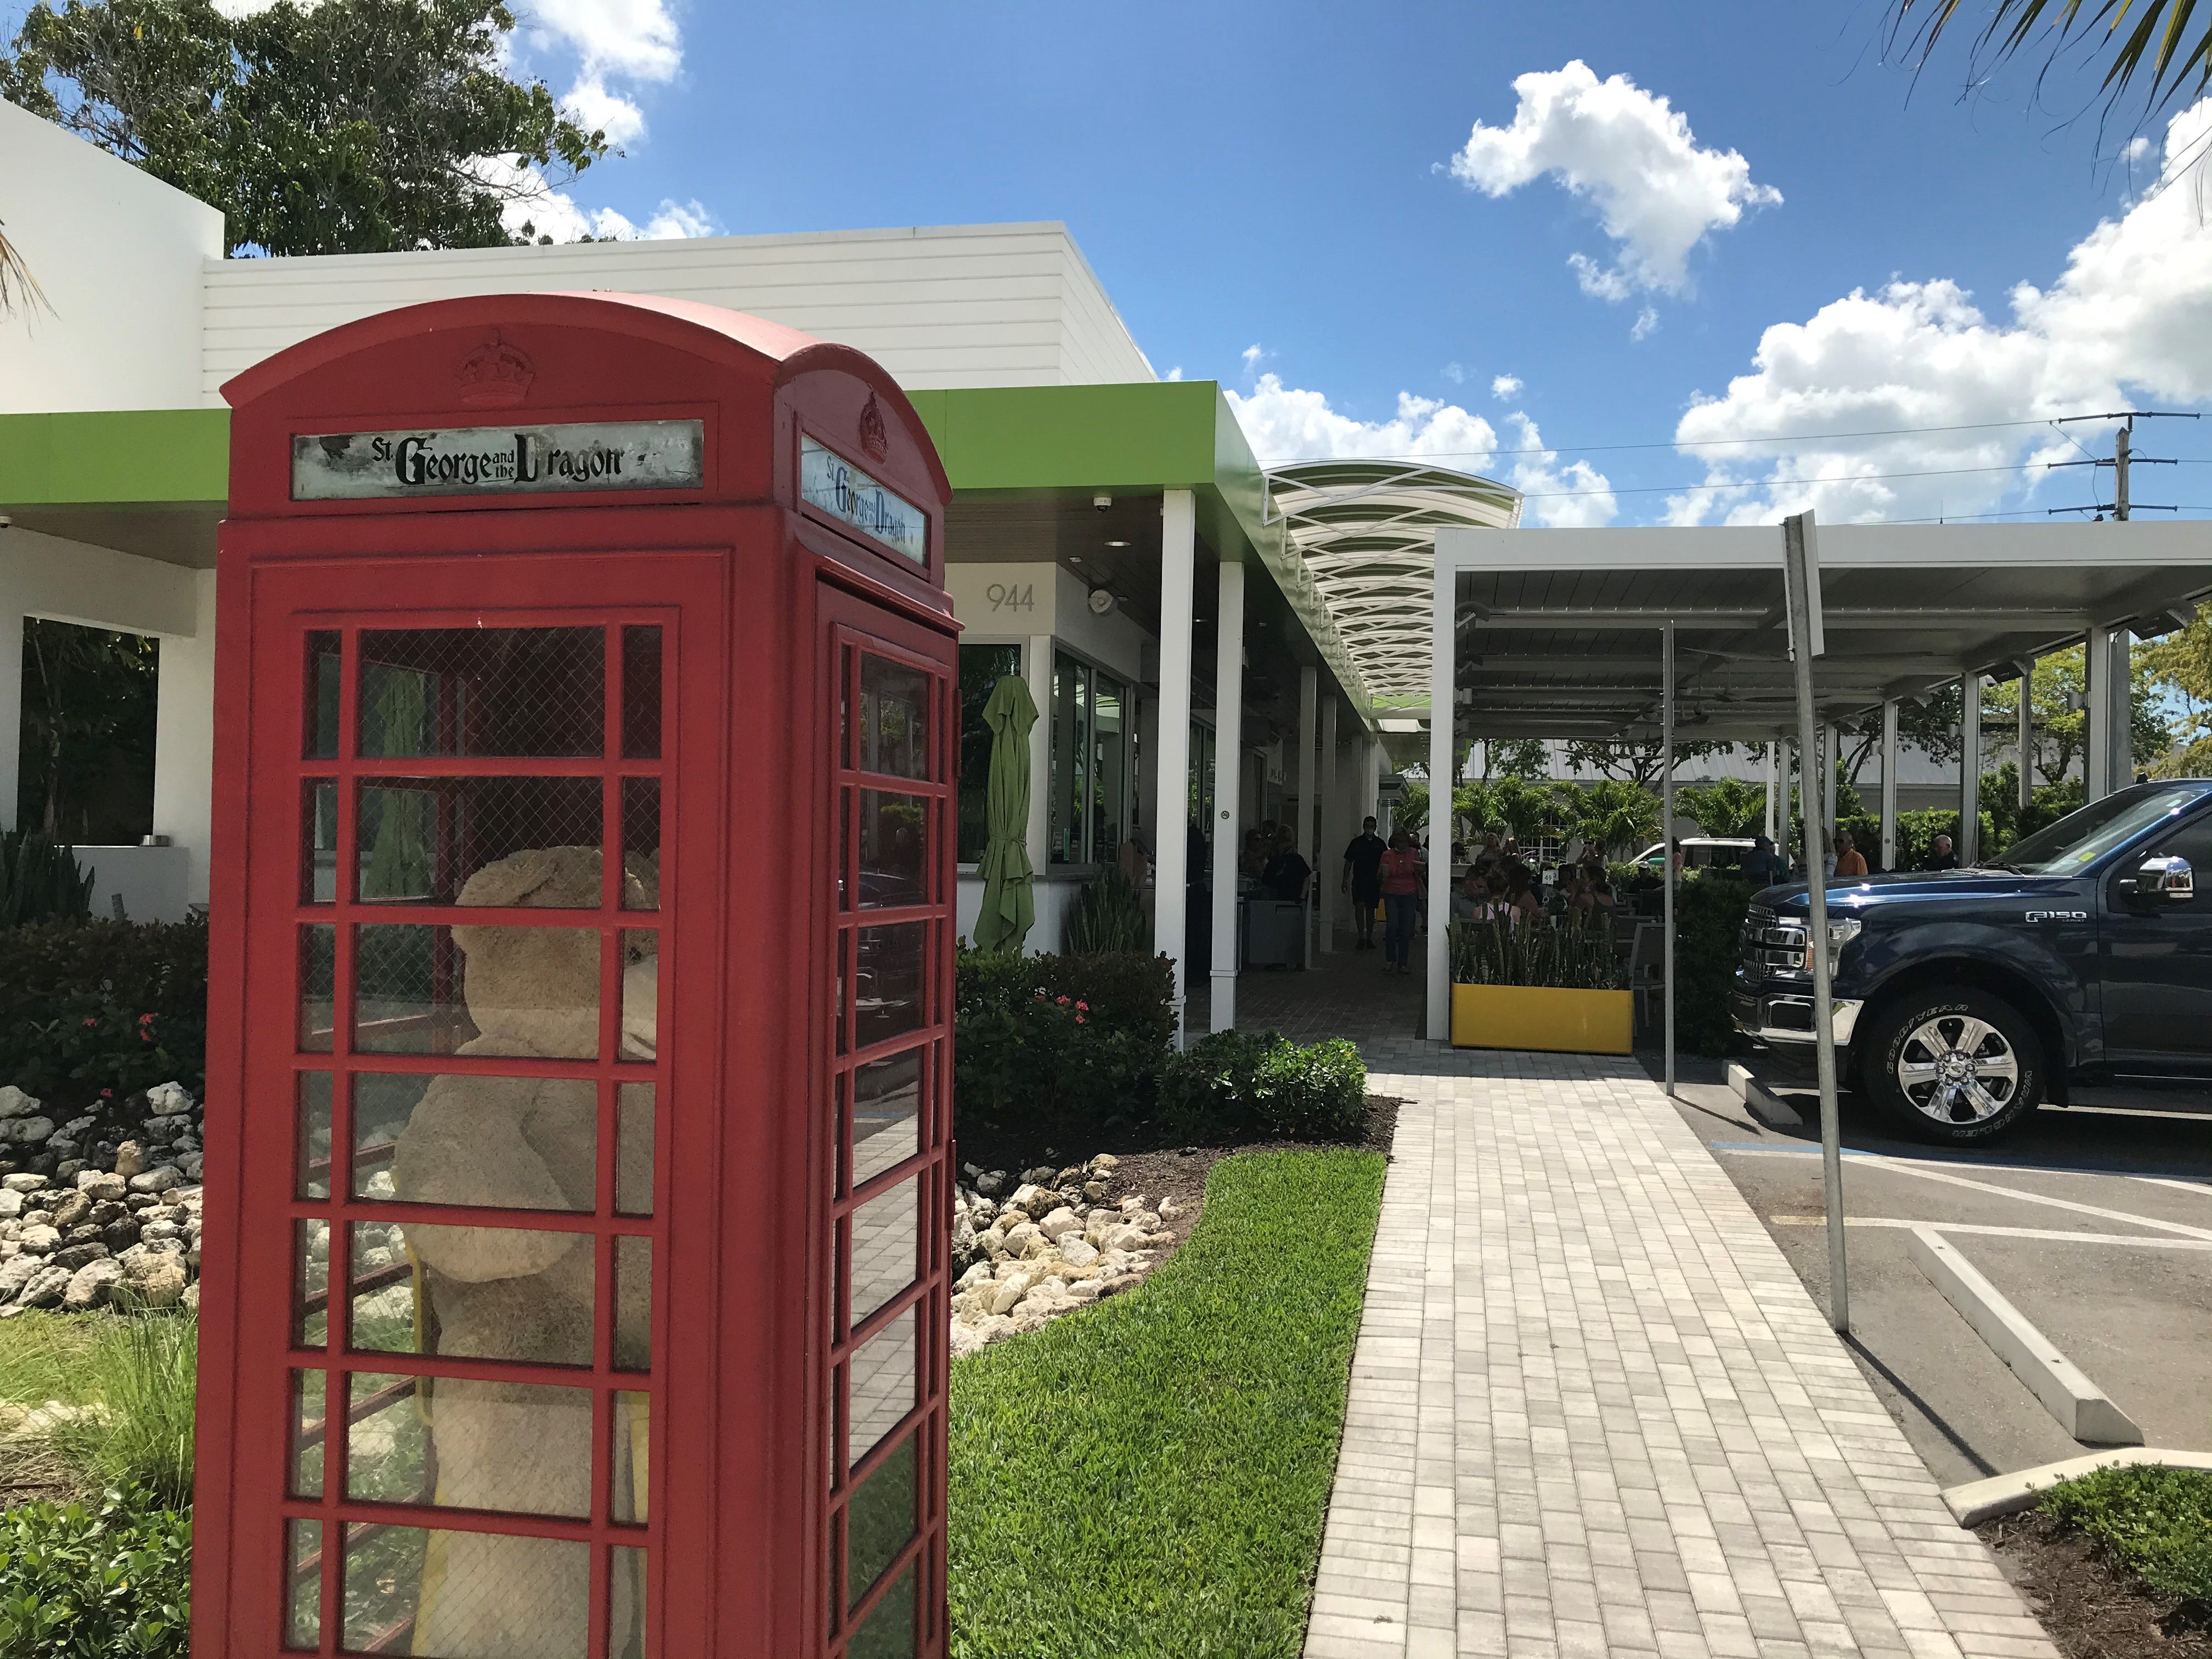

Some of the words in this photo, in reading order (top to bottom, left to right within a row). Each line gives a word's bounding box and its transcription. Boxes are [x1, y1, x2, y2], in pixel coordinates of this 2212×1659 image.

[372, 437, 393, 461] St.
[396, 437, 493, 485] George
[492, 449, 515, 464] and
[495, 466, 515, 478] the
[514, 433, 622, 483] Dragon
[835, 466, 868, 524] George
[986, 583, 1035, 612] 944
[1887, 1004, 1968, 1074] GOODYEAR
[1952, 1070, 2032, 1137] WRANGLER
